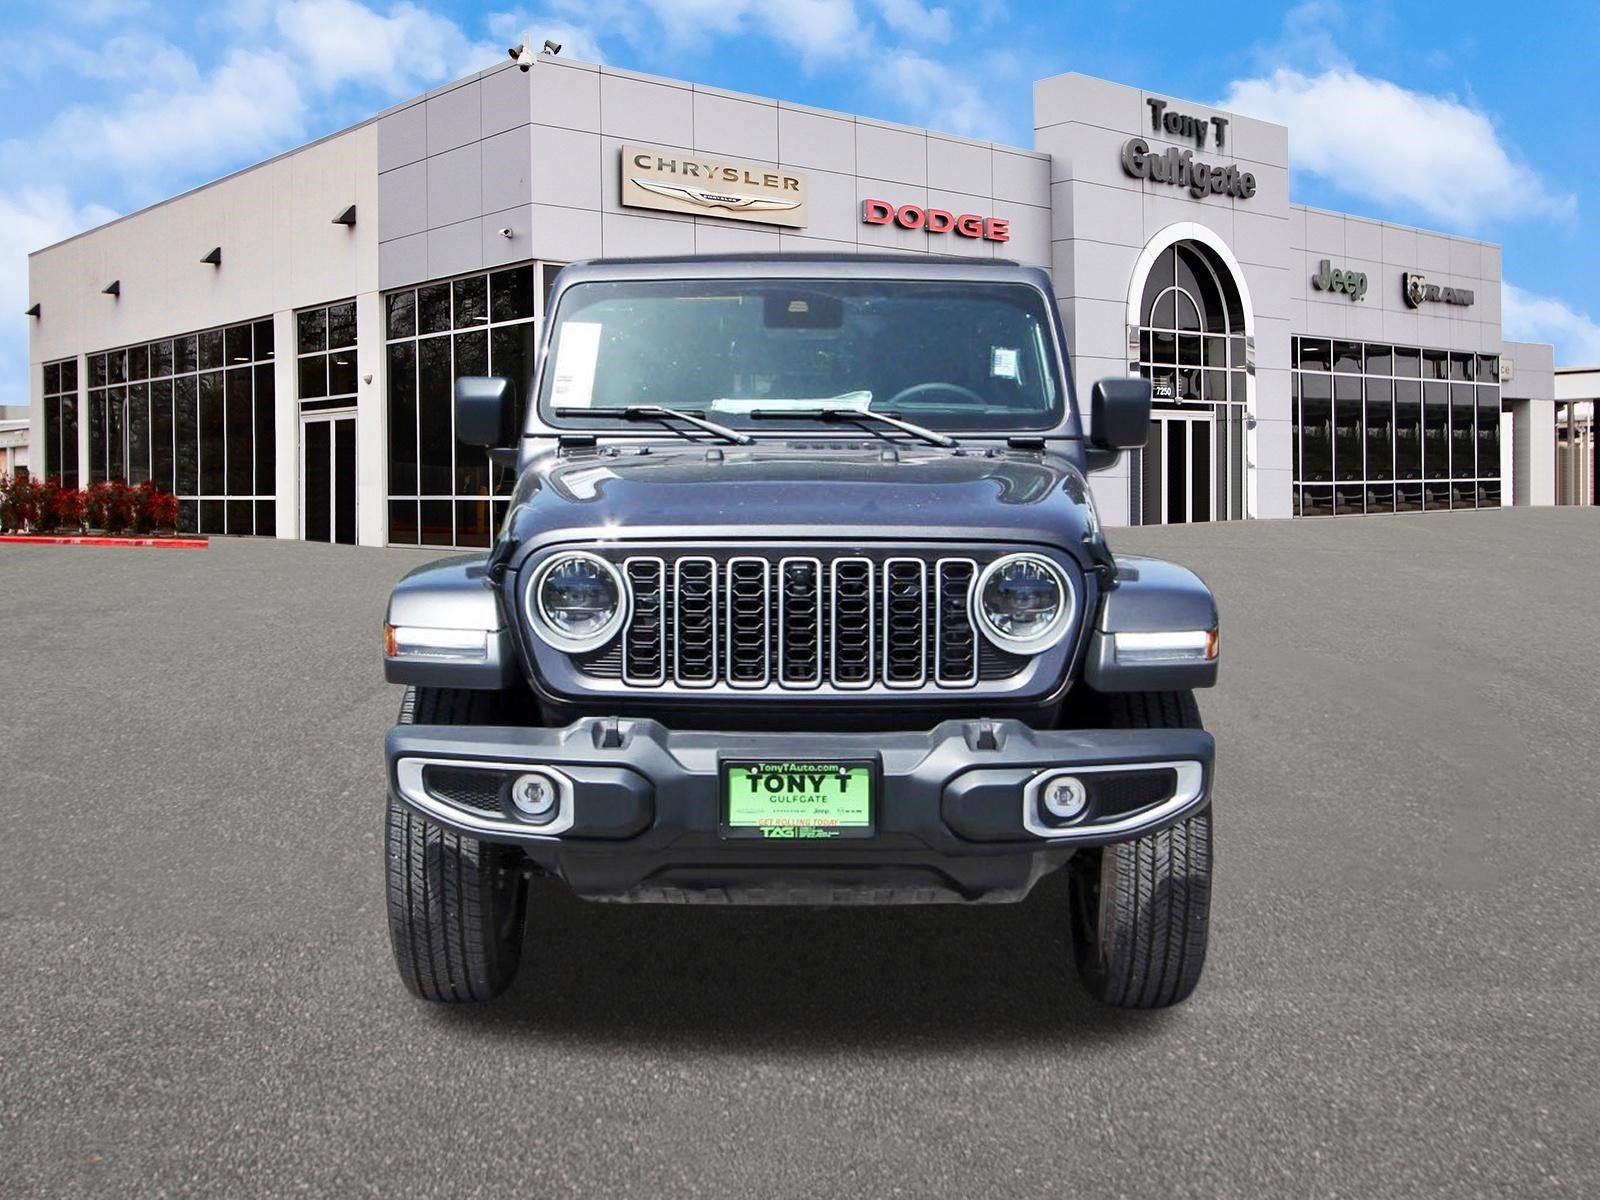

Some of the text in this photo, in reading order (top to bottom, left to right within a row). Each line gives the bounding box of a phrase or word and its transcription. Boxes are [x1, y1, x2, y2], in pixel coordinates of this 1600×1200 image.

[1147, 98, 1229, 148] Tony T
[634, 154, 800, 191] CHRYSLER
[1122, 138, 1256, 199] Gulfgate
[862, 199, 1009, 242] DODGE
[1312, 259, 1368, 302] Jeep
[1425, 284, 1474, 306] RAM
[1156, 386, 1171, 396] 7250
[758, 763, 839, 773] TonyTAuto.com
[746, 774, 852, 793] TONY T
[769, 795, 828, 804] GULFGATE
[760, 826, 794, 838] TAG
